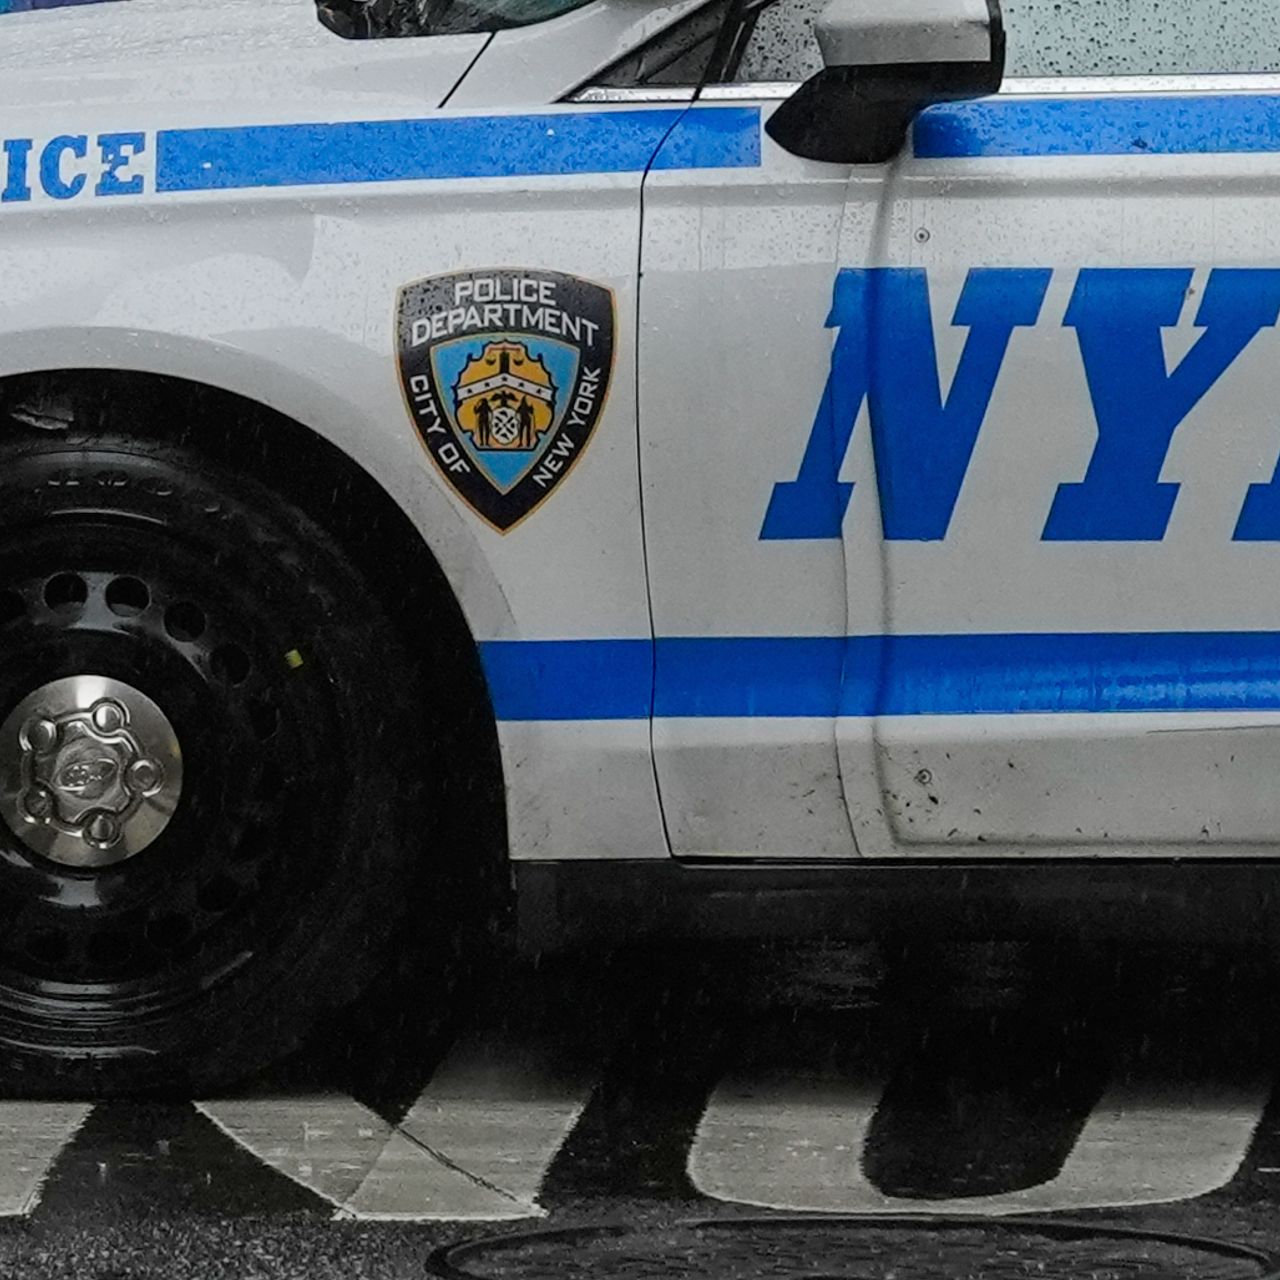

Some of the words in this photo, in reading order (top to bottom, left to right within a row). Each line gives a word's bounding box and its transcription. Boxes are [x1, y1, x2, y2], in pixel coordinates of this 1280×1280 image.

[410, 304, 600, 347] DEPARTMENT
[454, 278, 557, 306] POLICE
[409, 374, 448, 436] CITY
[438, 443, 471, 475] OF
[532, 433, 575, 488] NEW
[570, 365, 602, 427] YORK
